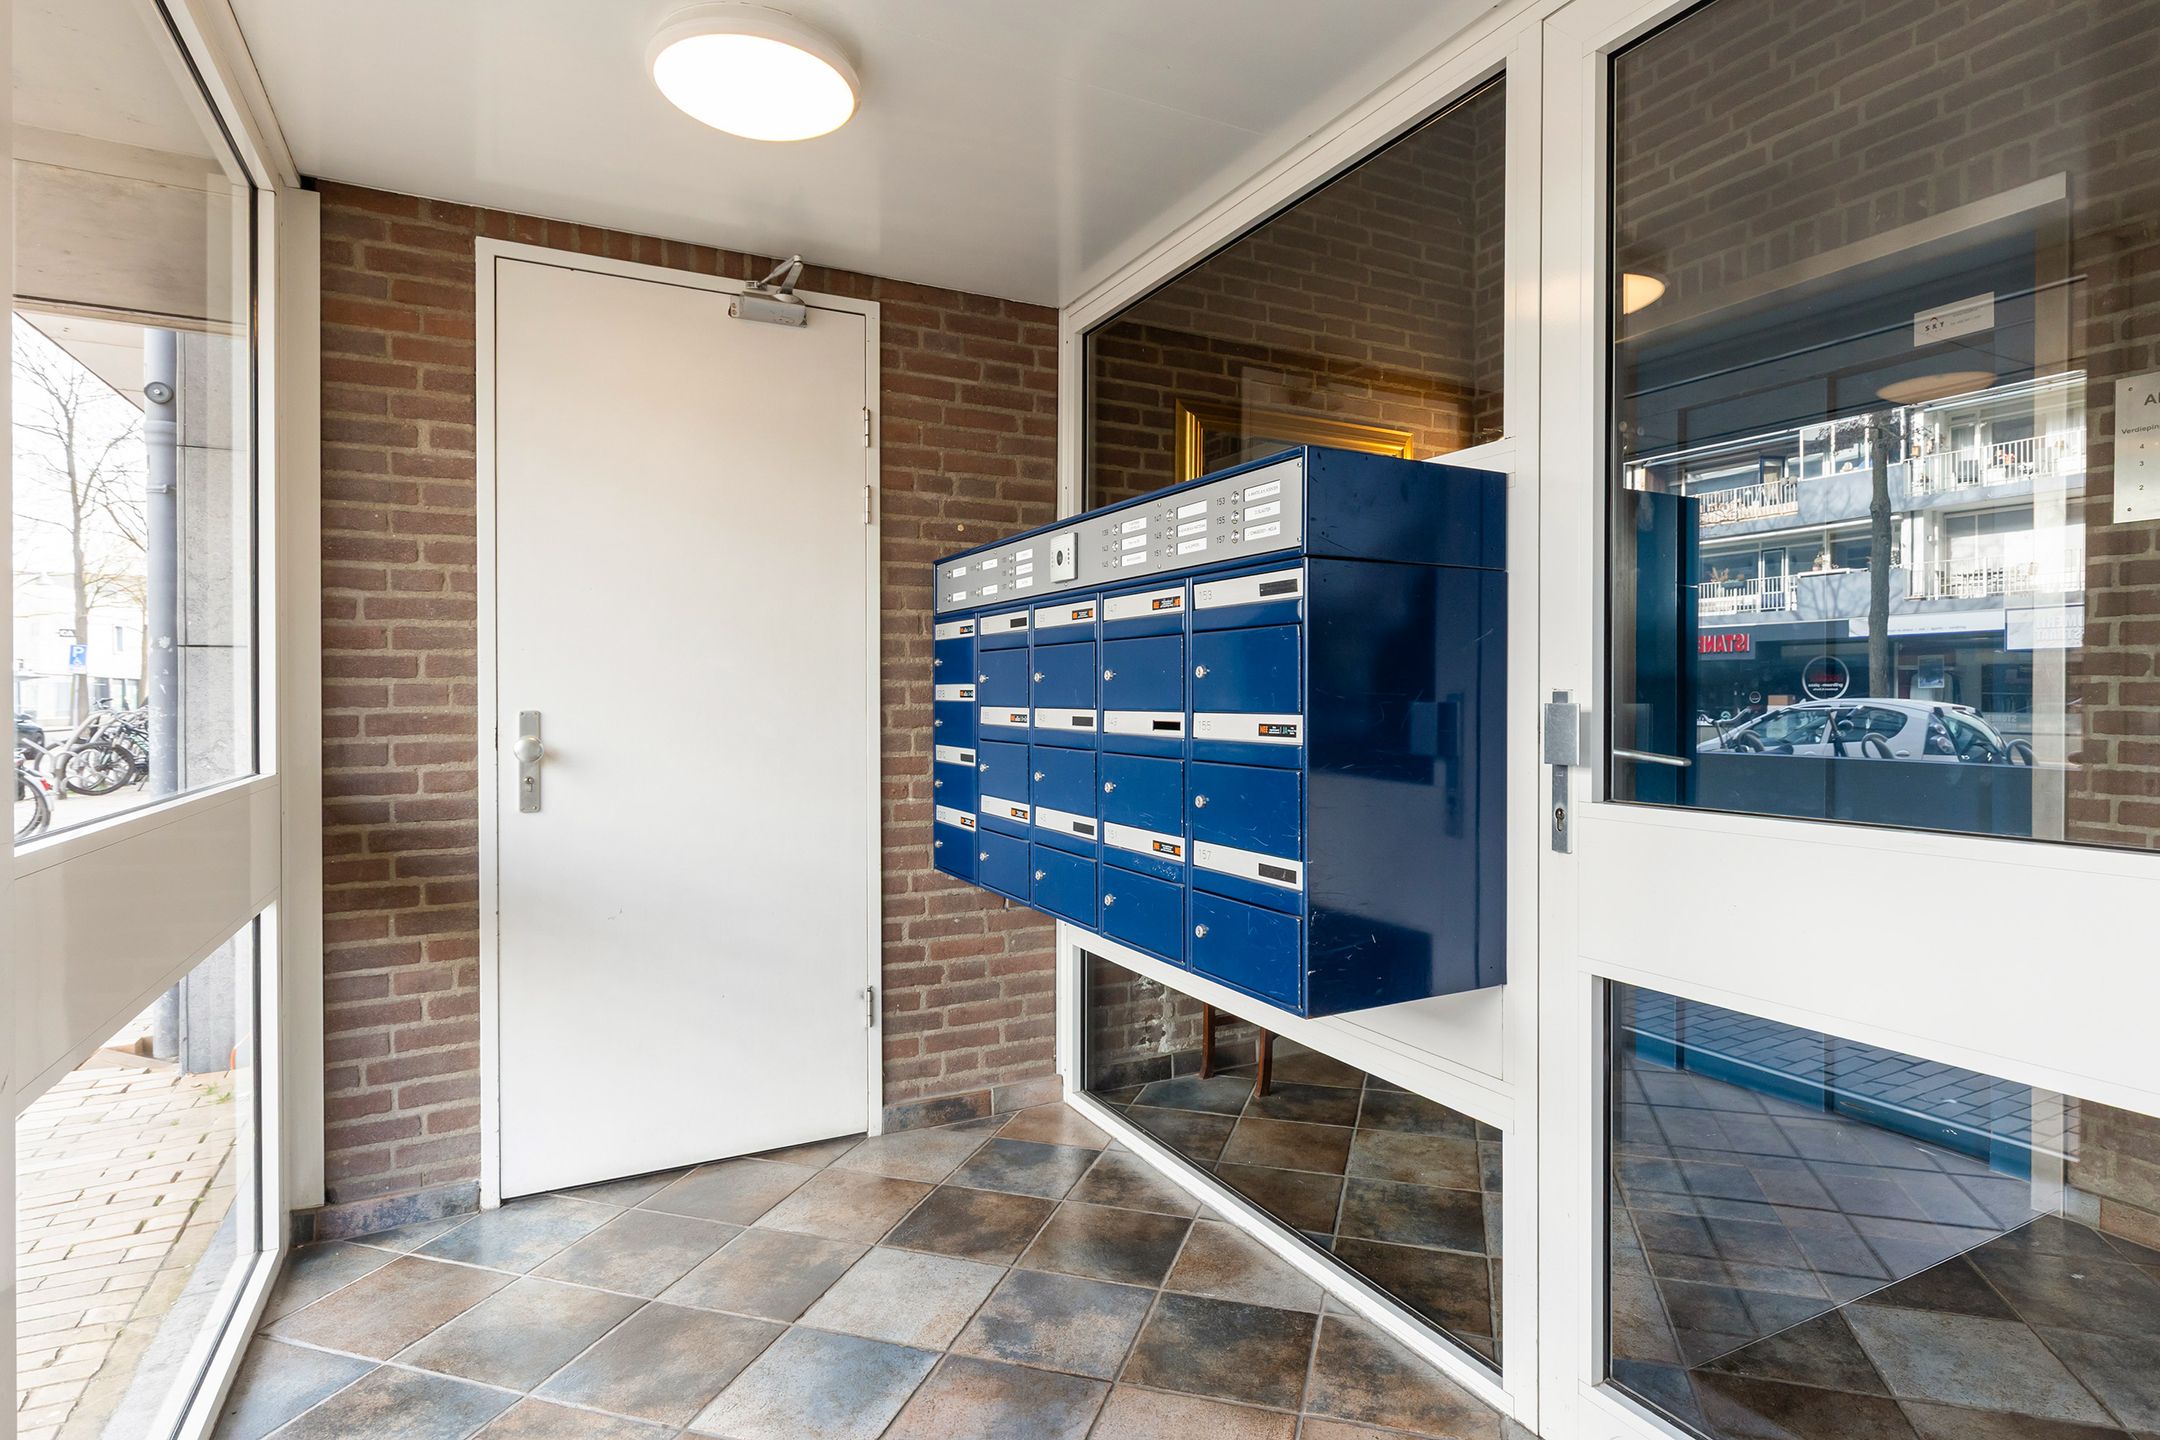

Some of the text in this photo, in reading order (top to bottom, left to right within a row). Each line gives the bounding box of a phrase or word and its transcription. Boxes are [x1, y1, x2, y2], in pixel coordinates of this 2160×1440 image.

[1925, 321, 1945, 332] SKY
[2121, 424, 2160, 435] Verdiepin
[1217, 497, 1226, 506] 153
[1217, 516, 1226, 525] 155
[1217, 535, 1226, 544] 157
[73, 646, 85, 658] P
[1199, 846, 1212, 861] 157
